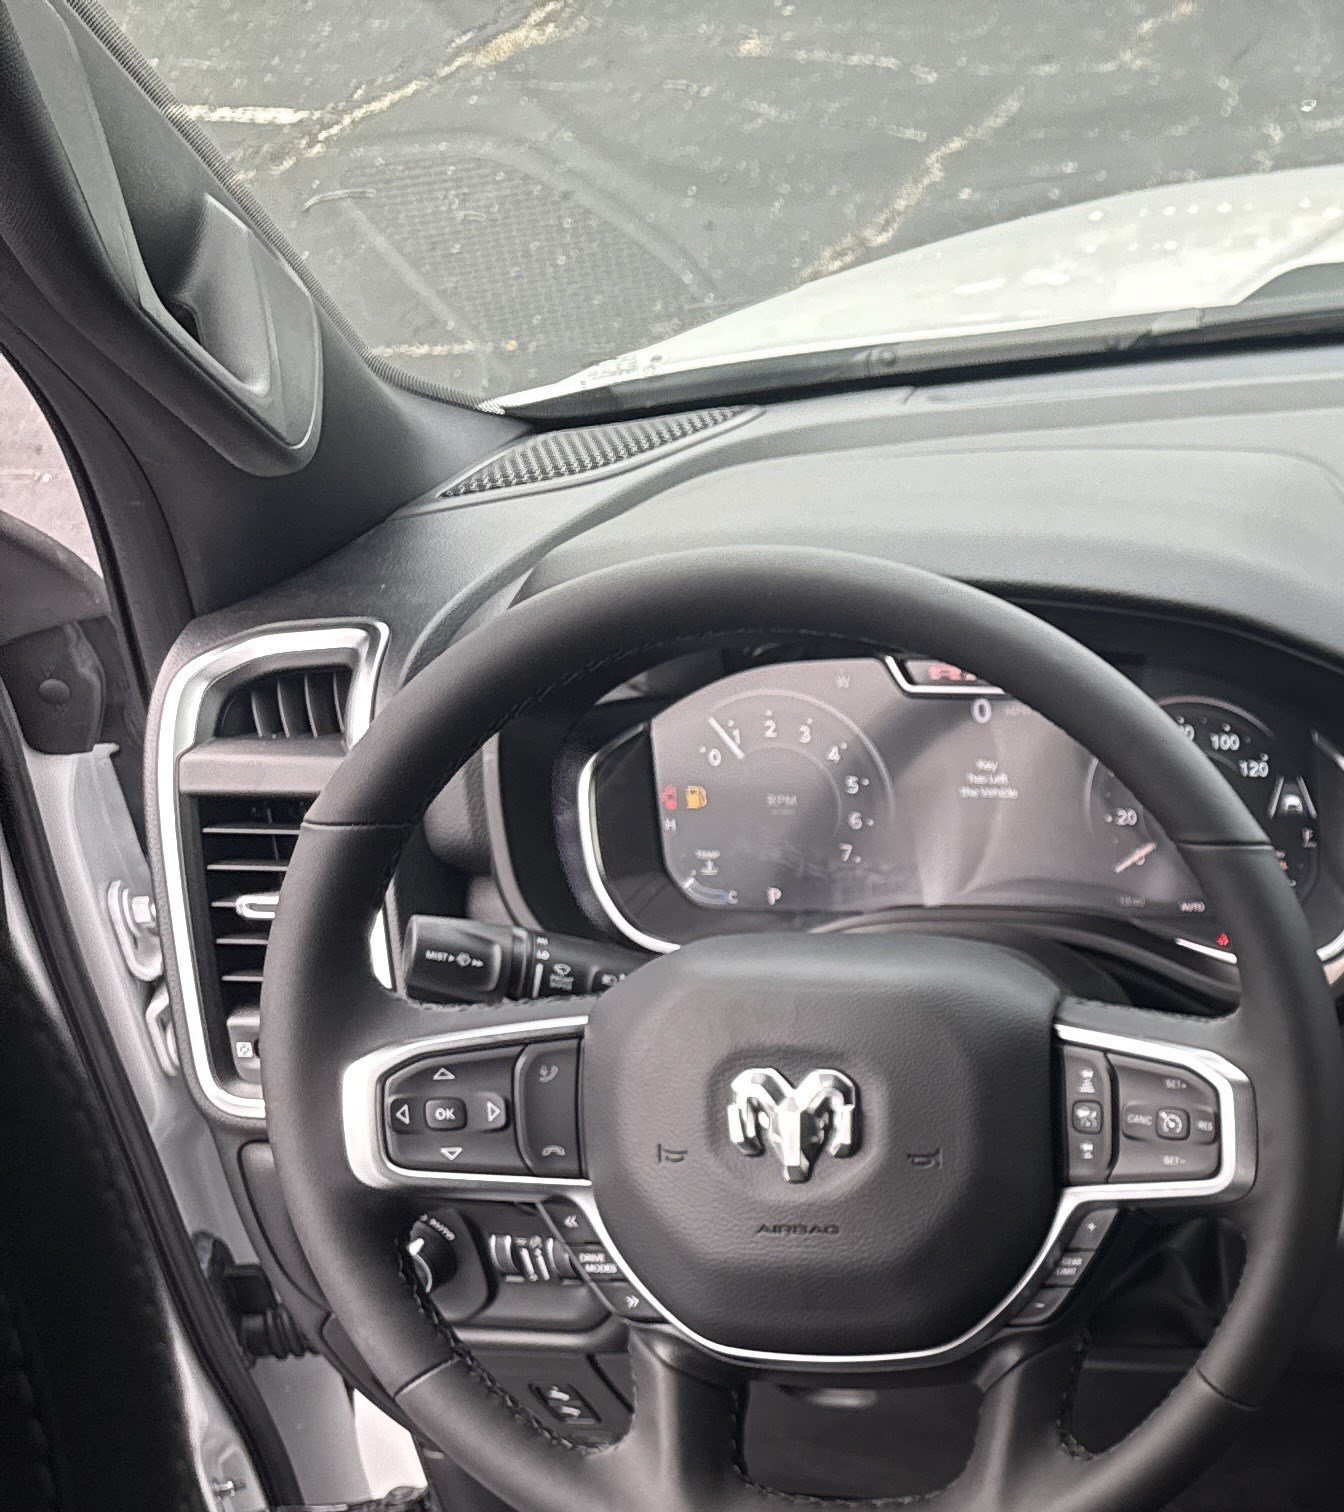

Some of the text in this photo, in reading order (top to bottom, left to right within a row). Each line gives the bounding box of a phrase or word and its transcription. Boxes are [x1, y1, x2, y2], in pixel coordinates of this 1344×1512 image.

[971, 698, 992, 724] 0
[732, 727, 741, 745] 1
[764, 719, 778, 738] 2
[799, 725, 811, 743] 3
[1209, 732, 1240, 751] 100
[707, 748, 722, 767] 0
[827, 745, 841, 763] 4
[1238, 758, 1269, 778] 120
[845, 774, 860, 795] 5
[848, 811, 863, 830] 6
[1114, 807, 1138, 826] 20
[839, 843, 853, 862] 7
[766, 886, 782, 905] P
[434, 1106, 456, 1121] OK
[1197, 1120, 1214, 1132] RES
[756, 1223, 840, 1235] AIRBAG
